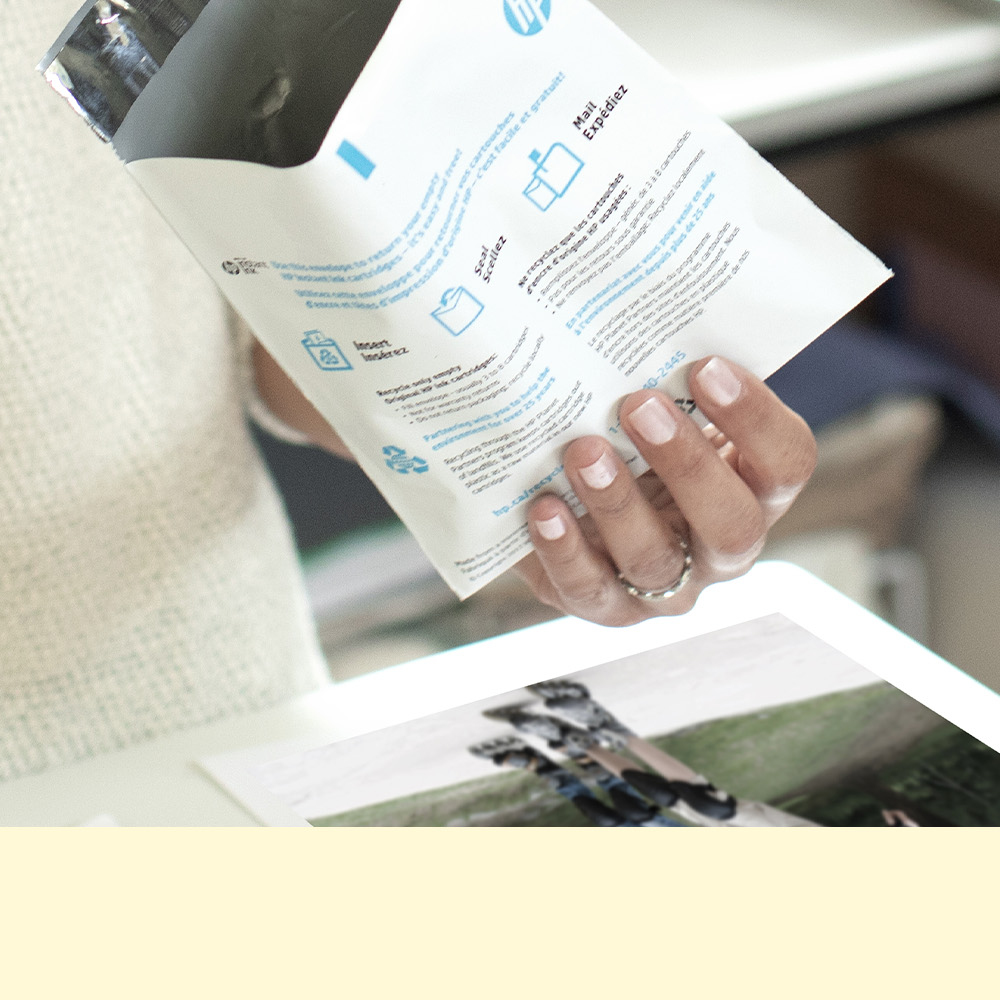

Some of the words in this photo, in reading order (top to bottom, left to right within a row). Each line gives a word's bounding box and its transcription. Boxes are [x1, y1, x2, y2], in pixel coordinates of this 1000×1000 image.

[494, 124, 521, 153] facile
[520, 112, 531, 124] et
[531, 72, 565, 113] gratuit!
[573, 100, 597, 130] Mail
[583, 85, 628, 140] Expédiez
[469, 112, 515, 168] cartouches
[574, 216, 589, 232] les
[587, 173, 624, 219] cartouches
[692, 205, 706, 221] 25
[401, 211, 421, 237] your
[475, 245, 488, 276] Seal
[483, 236, 507, 284] Scellez
[353, 340, 392, 350] Insert
[361, 347, 409, 361] Insérez
